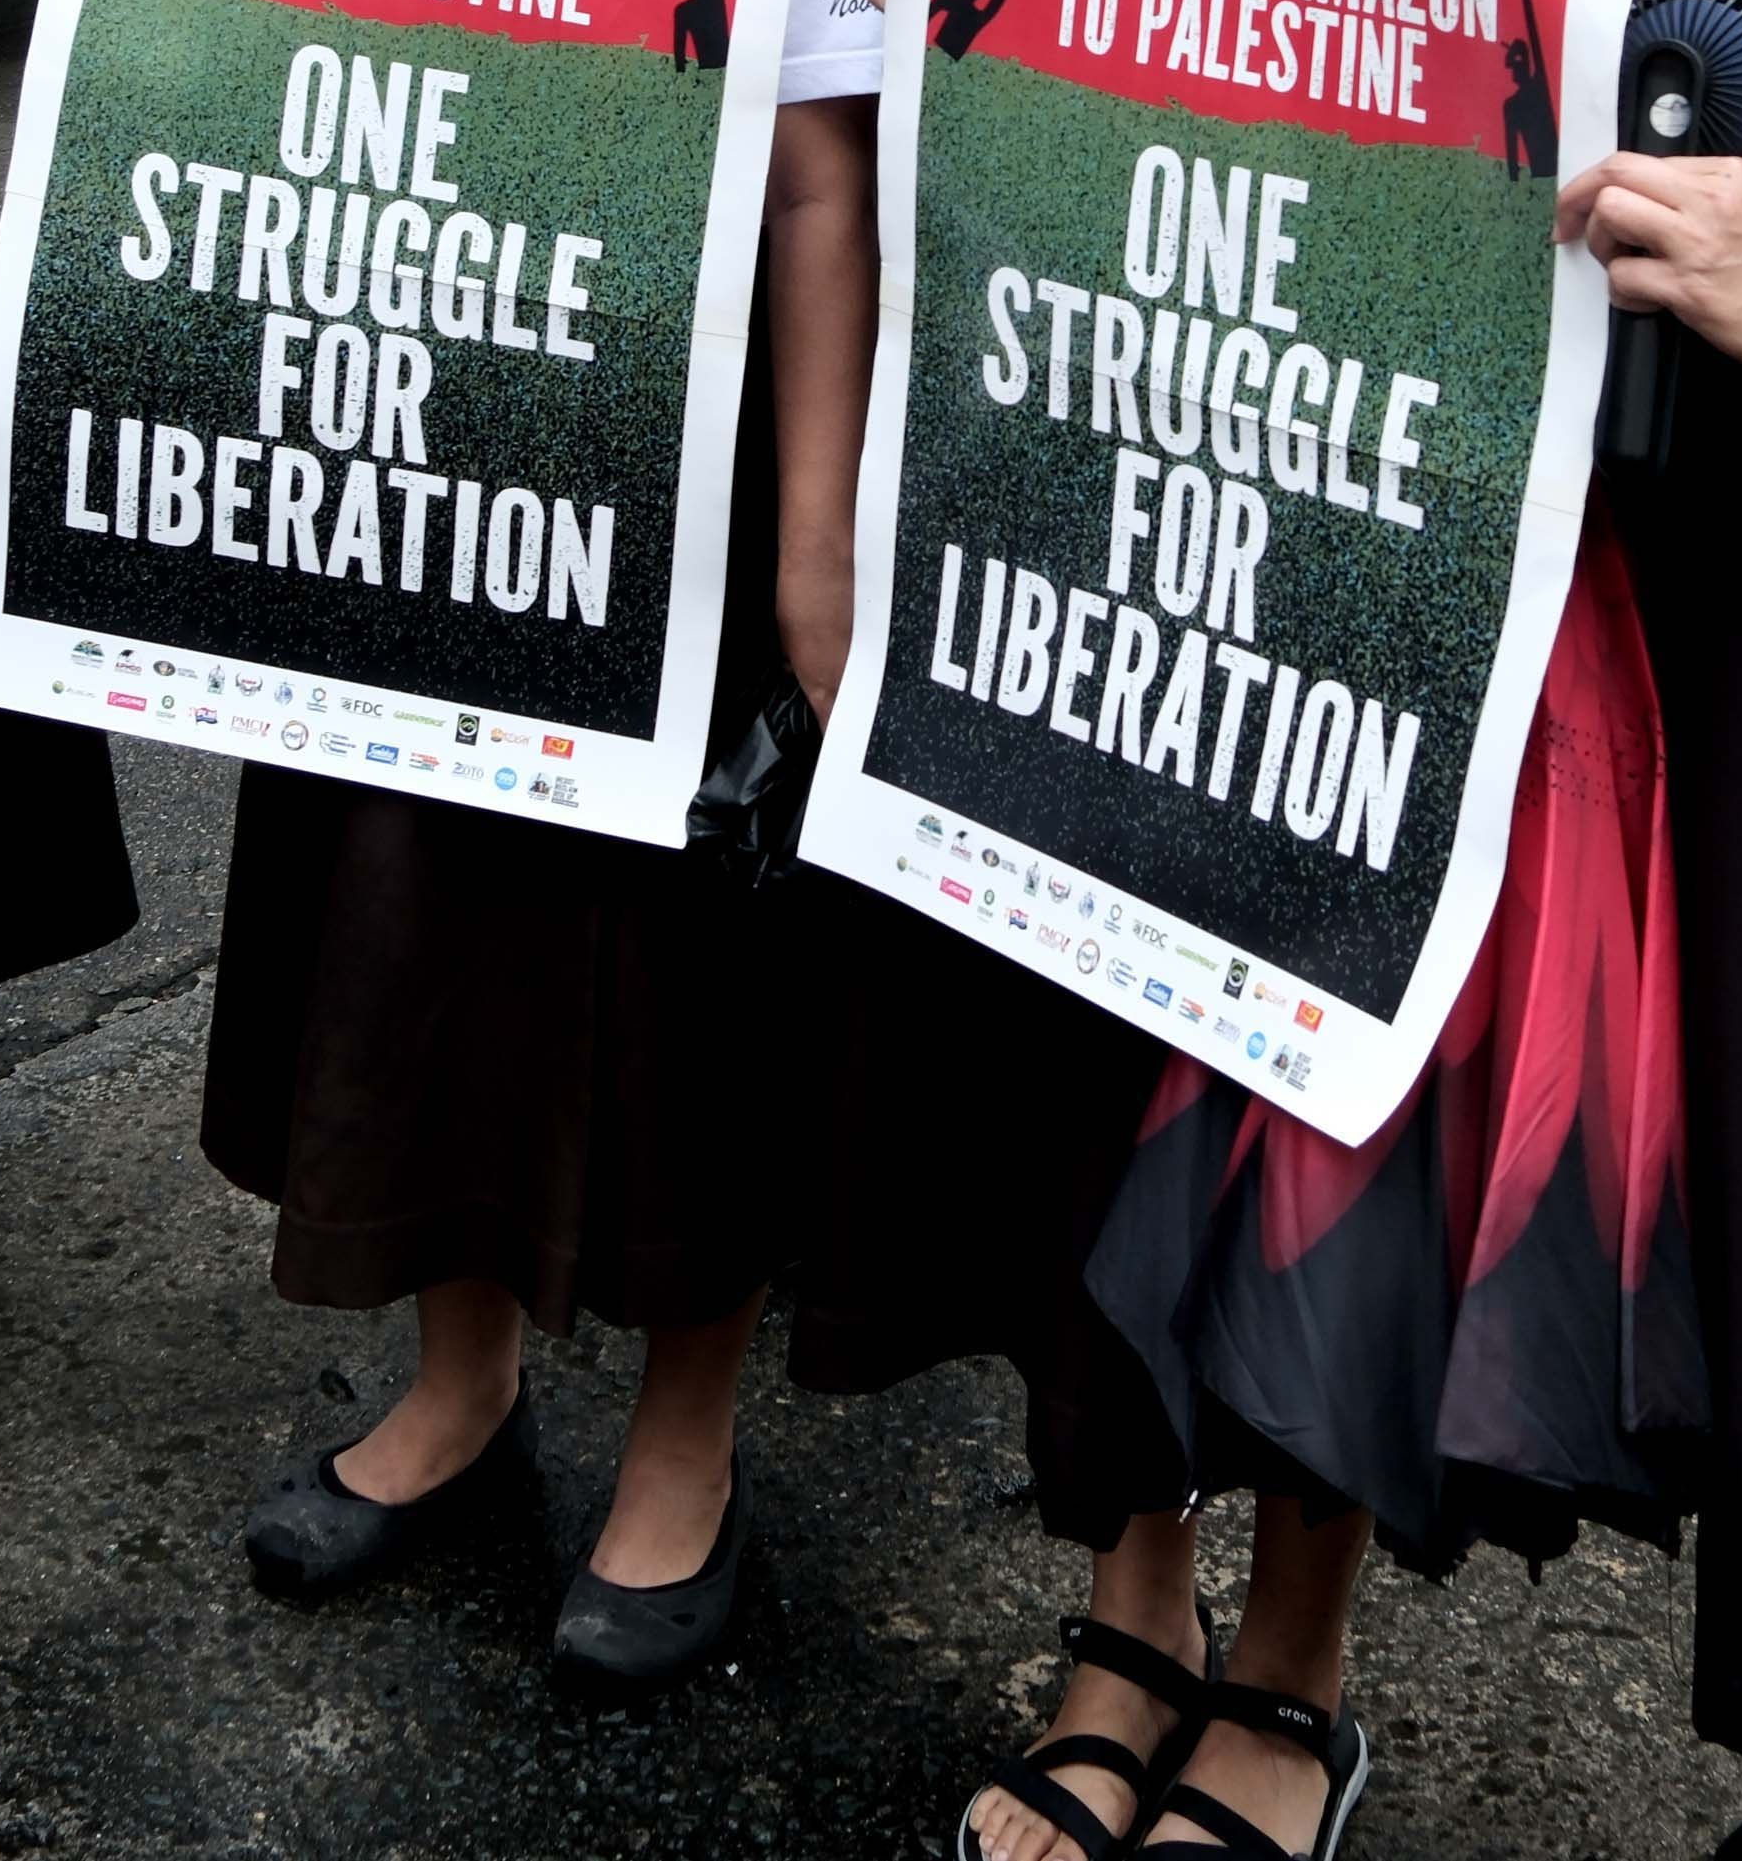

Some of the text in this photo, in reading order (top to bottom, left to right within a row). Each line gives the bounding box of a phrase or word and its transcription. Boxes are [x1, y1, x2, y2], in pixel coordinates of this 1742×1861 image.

[278, 44, 470, 202] ONE
[119, 152, 603, 362] STRUGGLE
[1127, 145, 1309, 332] ONE
[258, 311, 433, 465] FOR
[982, 268, 1441, 531] STRUGGLE
[64, 408, 614, 629] LIBERATION
[1106, 446, 1270, 643] FOR
[354, 700, 384, 717] FDC
[930, 543, 1421, 876] LIBERATION
[1142, 924, 1169, 949] FDC
